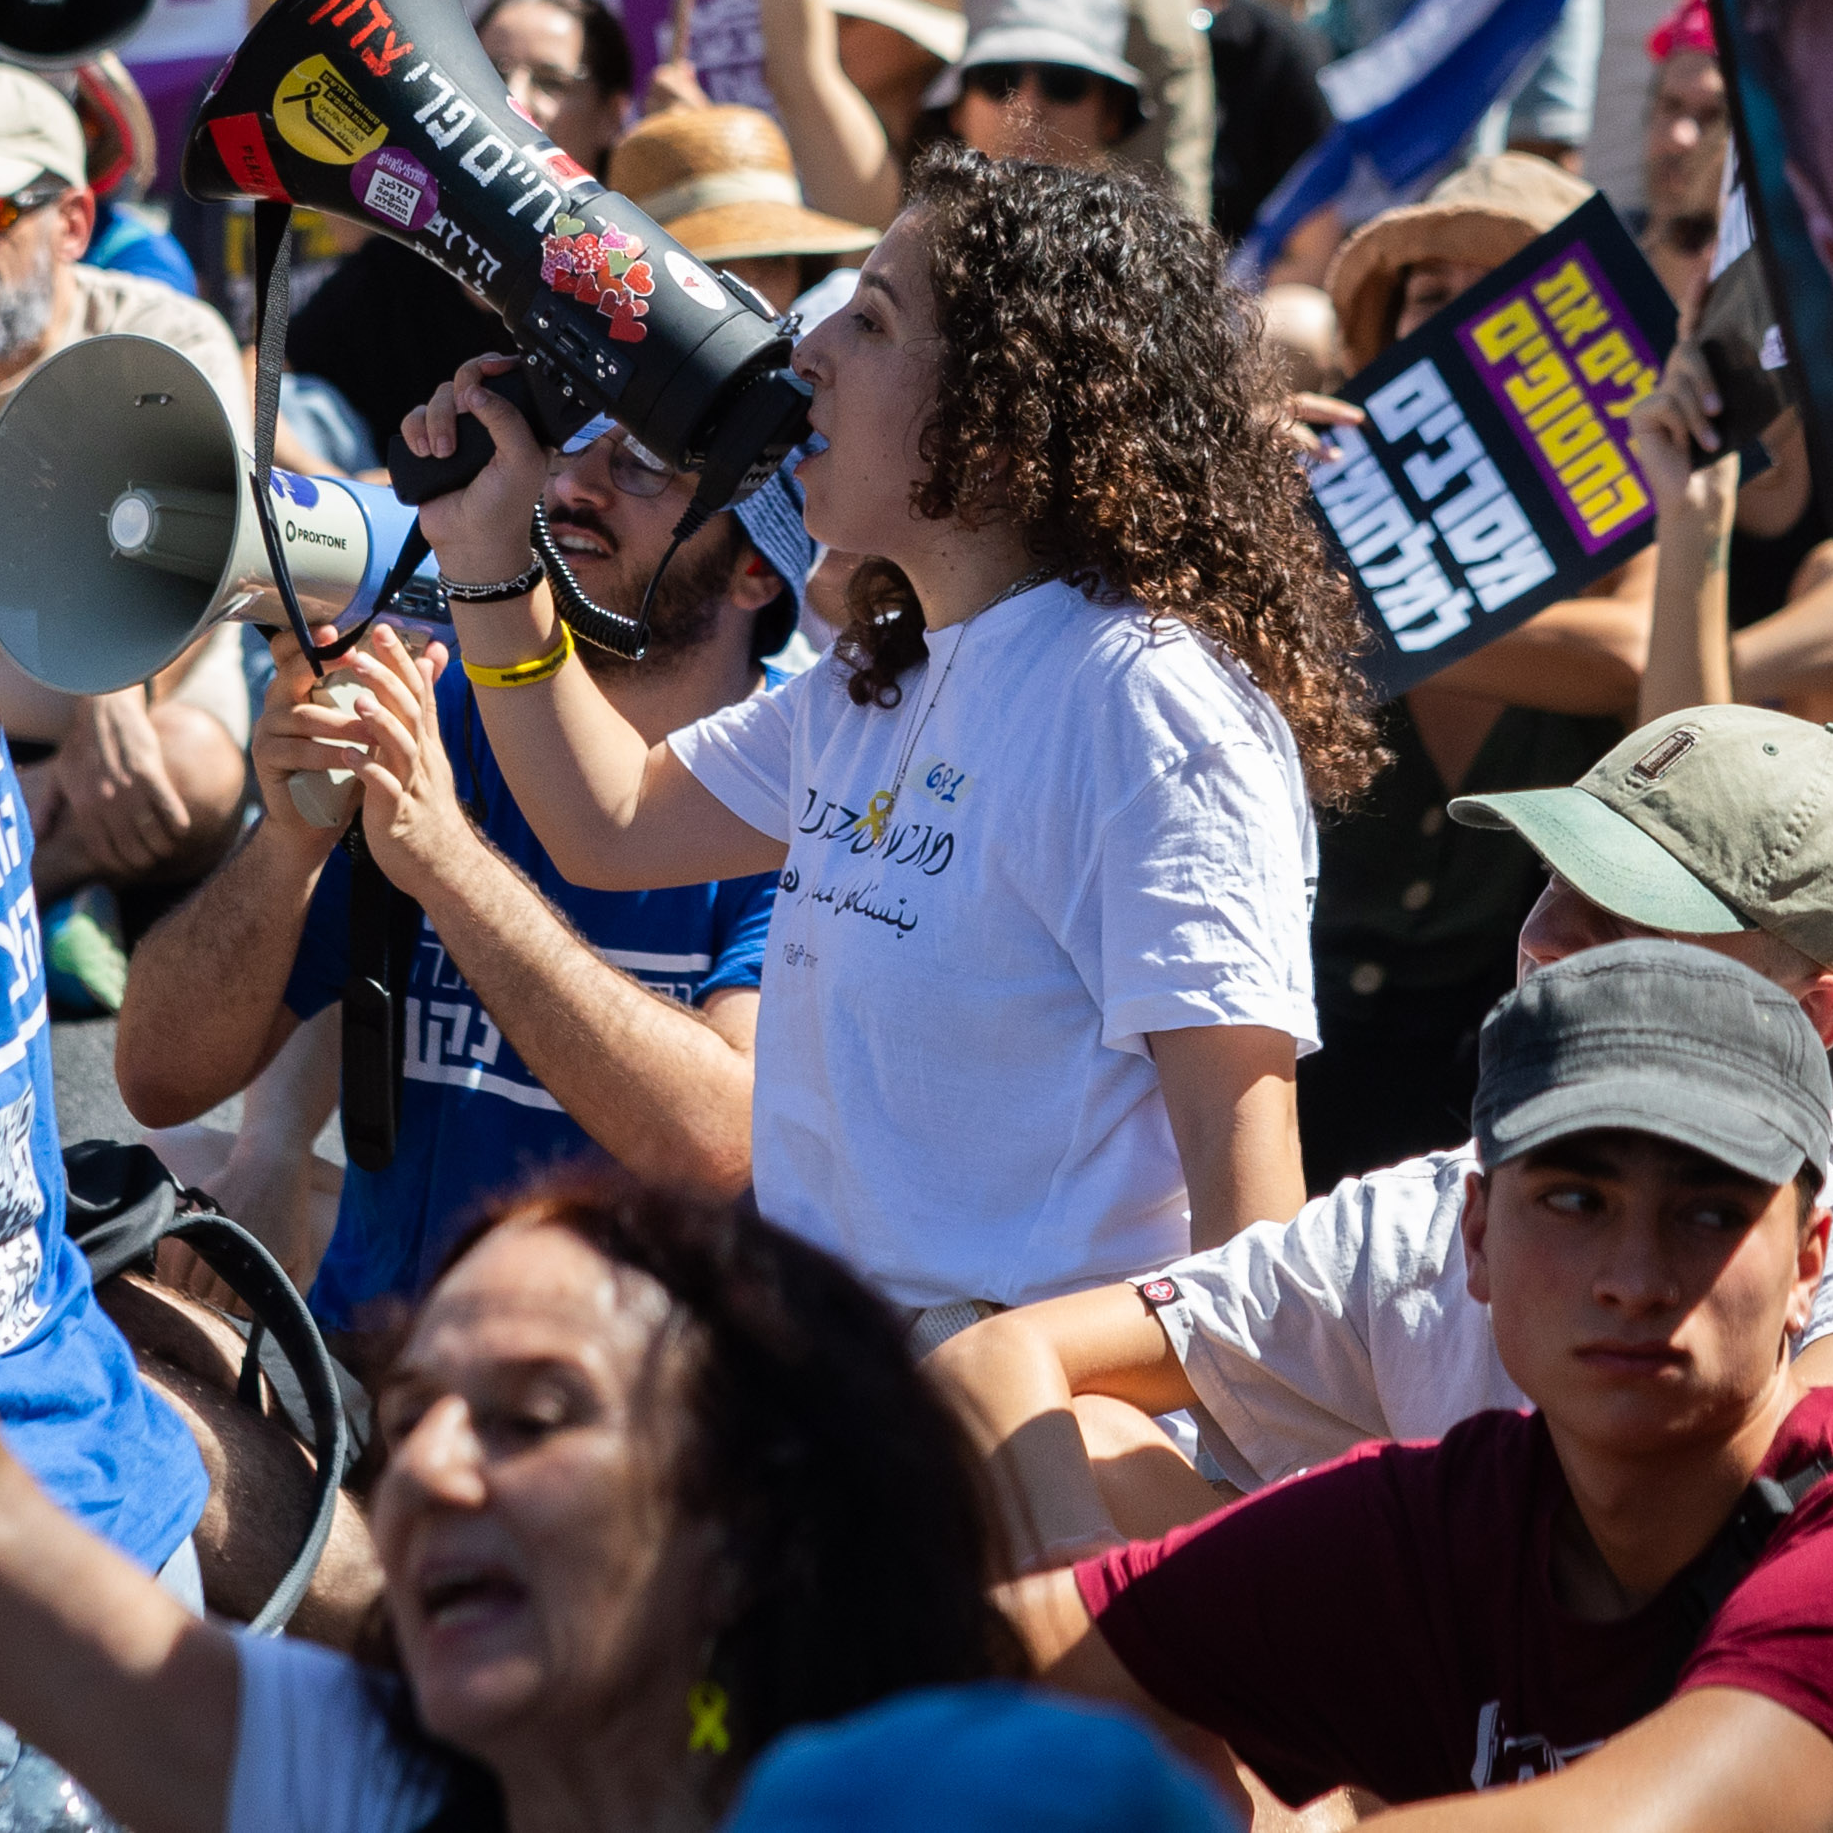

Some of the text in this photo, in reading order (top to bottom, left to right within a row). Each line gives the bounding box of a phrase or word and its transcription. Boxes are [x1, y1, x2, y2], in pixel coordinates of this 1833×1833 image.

[403, 61, 477, 150] פרי
[396, 182, 416, 200] נגד
[459, 134, 563, 233] חיים
[1533, 259, 1612, 346] את
[1470, 298, 1648, 538] החטופים
[1365, 357, 1557, 613] מסרבים
[297, 527, 348, 551] PROXTONE
[925, 762, 965, 804] 681
